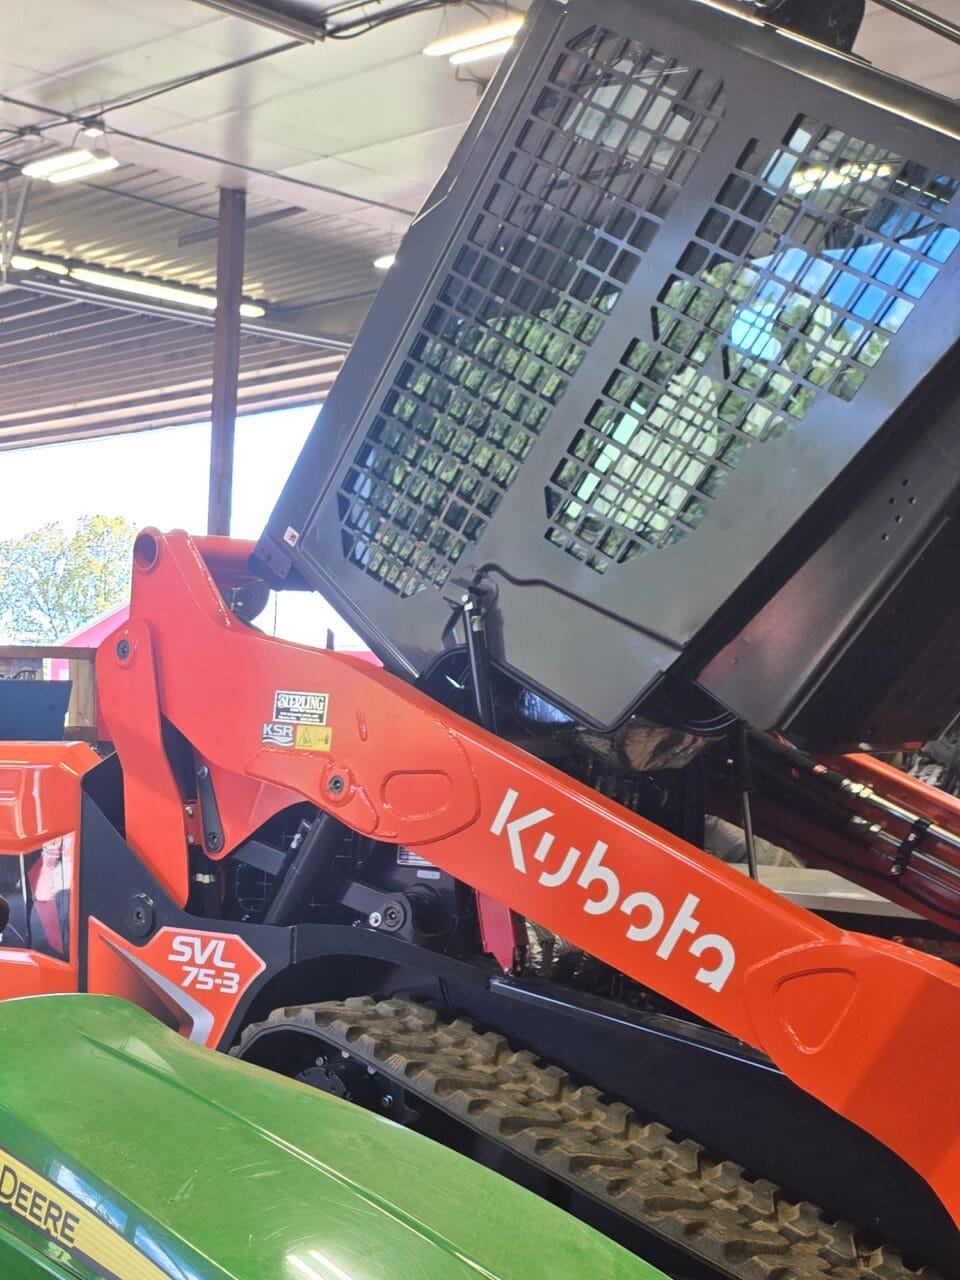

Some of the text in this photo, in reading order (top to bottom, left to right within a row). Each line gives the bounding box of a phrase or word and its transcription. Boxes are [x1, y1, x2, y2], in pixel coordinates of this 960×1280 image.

[262, 723, 294, 737] KSR
[489, 787, 736, 993] Kubota
[167, 935, 236, 969] SVL
[181, 965, 240, 994] 75-3
